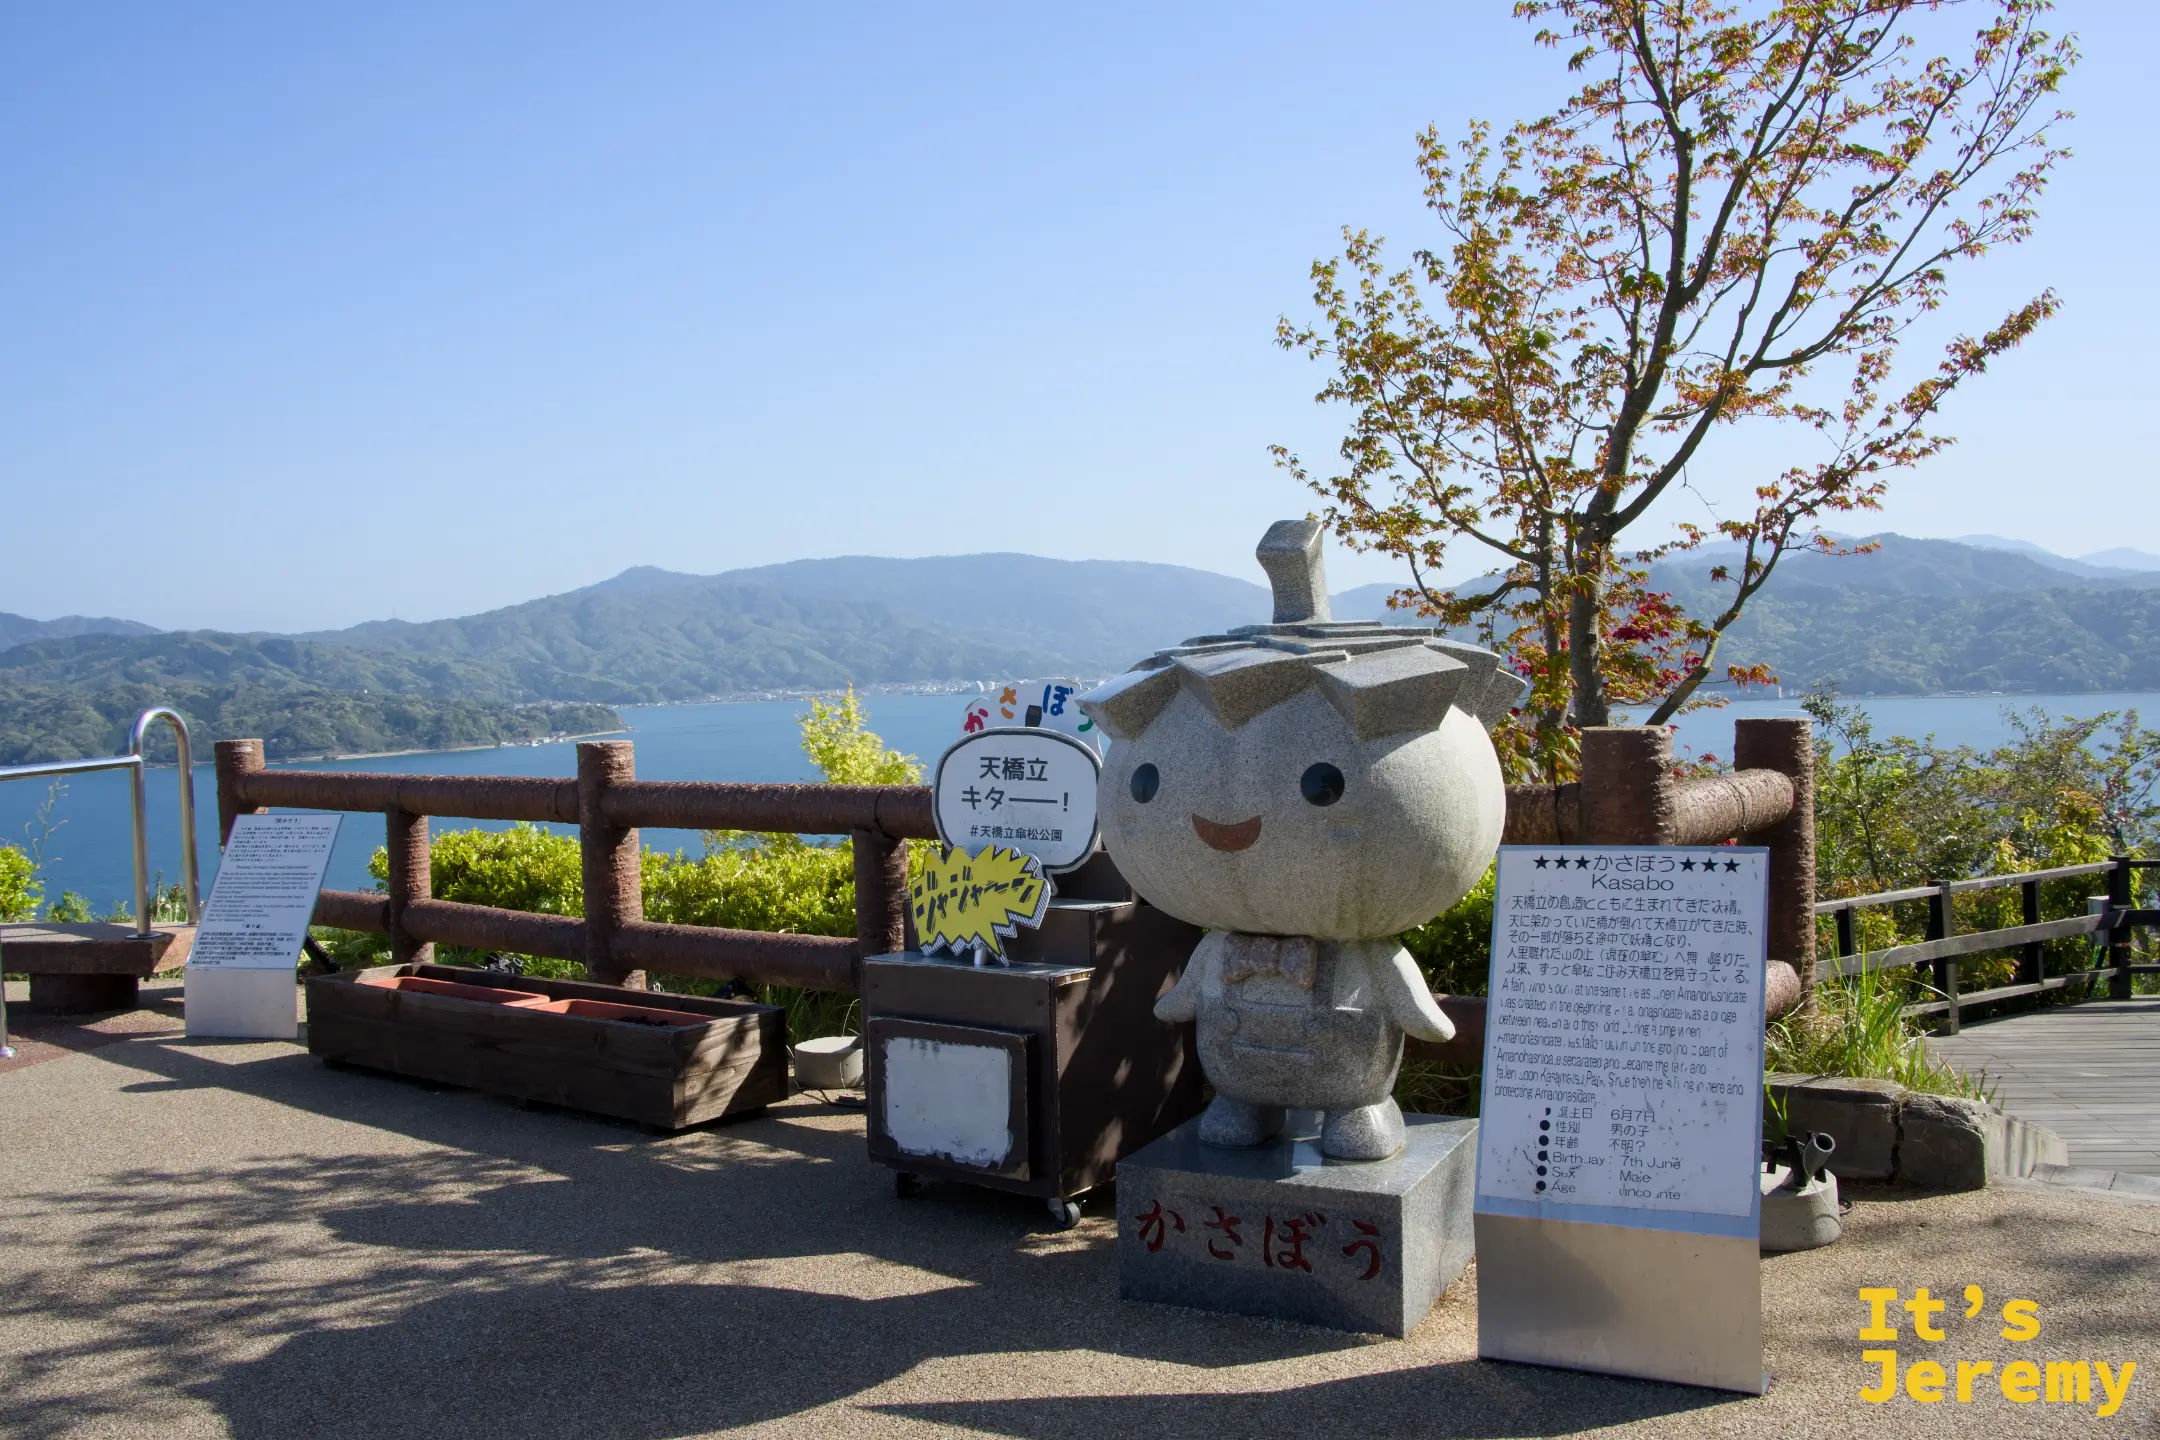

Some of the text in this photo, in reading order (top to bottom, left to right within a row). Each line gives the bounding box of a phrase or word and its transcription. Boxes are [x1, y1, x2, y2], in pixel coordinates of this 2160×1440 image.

[979, 756, 1048, 782] 天橋立
[970, 824, 1062, 842] #天橋立傘松公園
[1593, 854, 1676, 874] かさぼう
[1592, 874, 1674, 891] Kasabo
[1502, 978, 1508, 990] A
[1600, 986, 1621, 997] same
[1641, 988, 1650, 999] as
[1718, 1043, 1728, 1058] of
[1610, 1109, 1655, 1122] 6月7日
[1556, 1121, 1649, 1137] 性別 男の子
[1554, 1136, 1579, 1148] 年齢
[1620, 1154, 1643, 1167] 7th
[1551, 1181, 1576, 1193] Age
[1135, 1200, 1381, 1281] かさぼう
